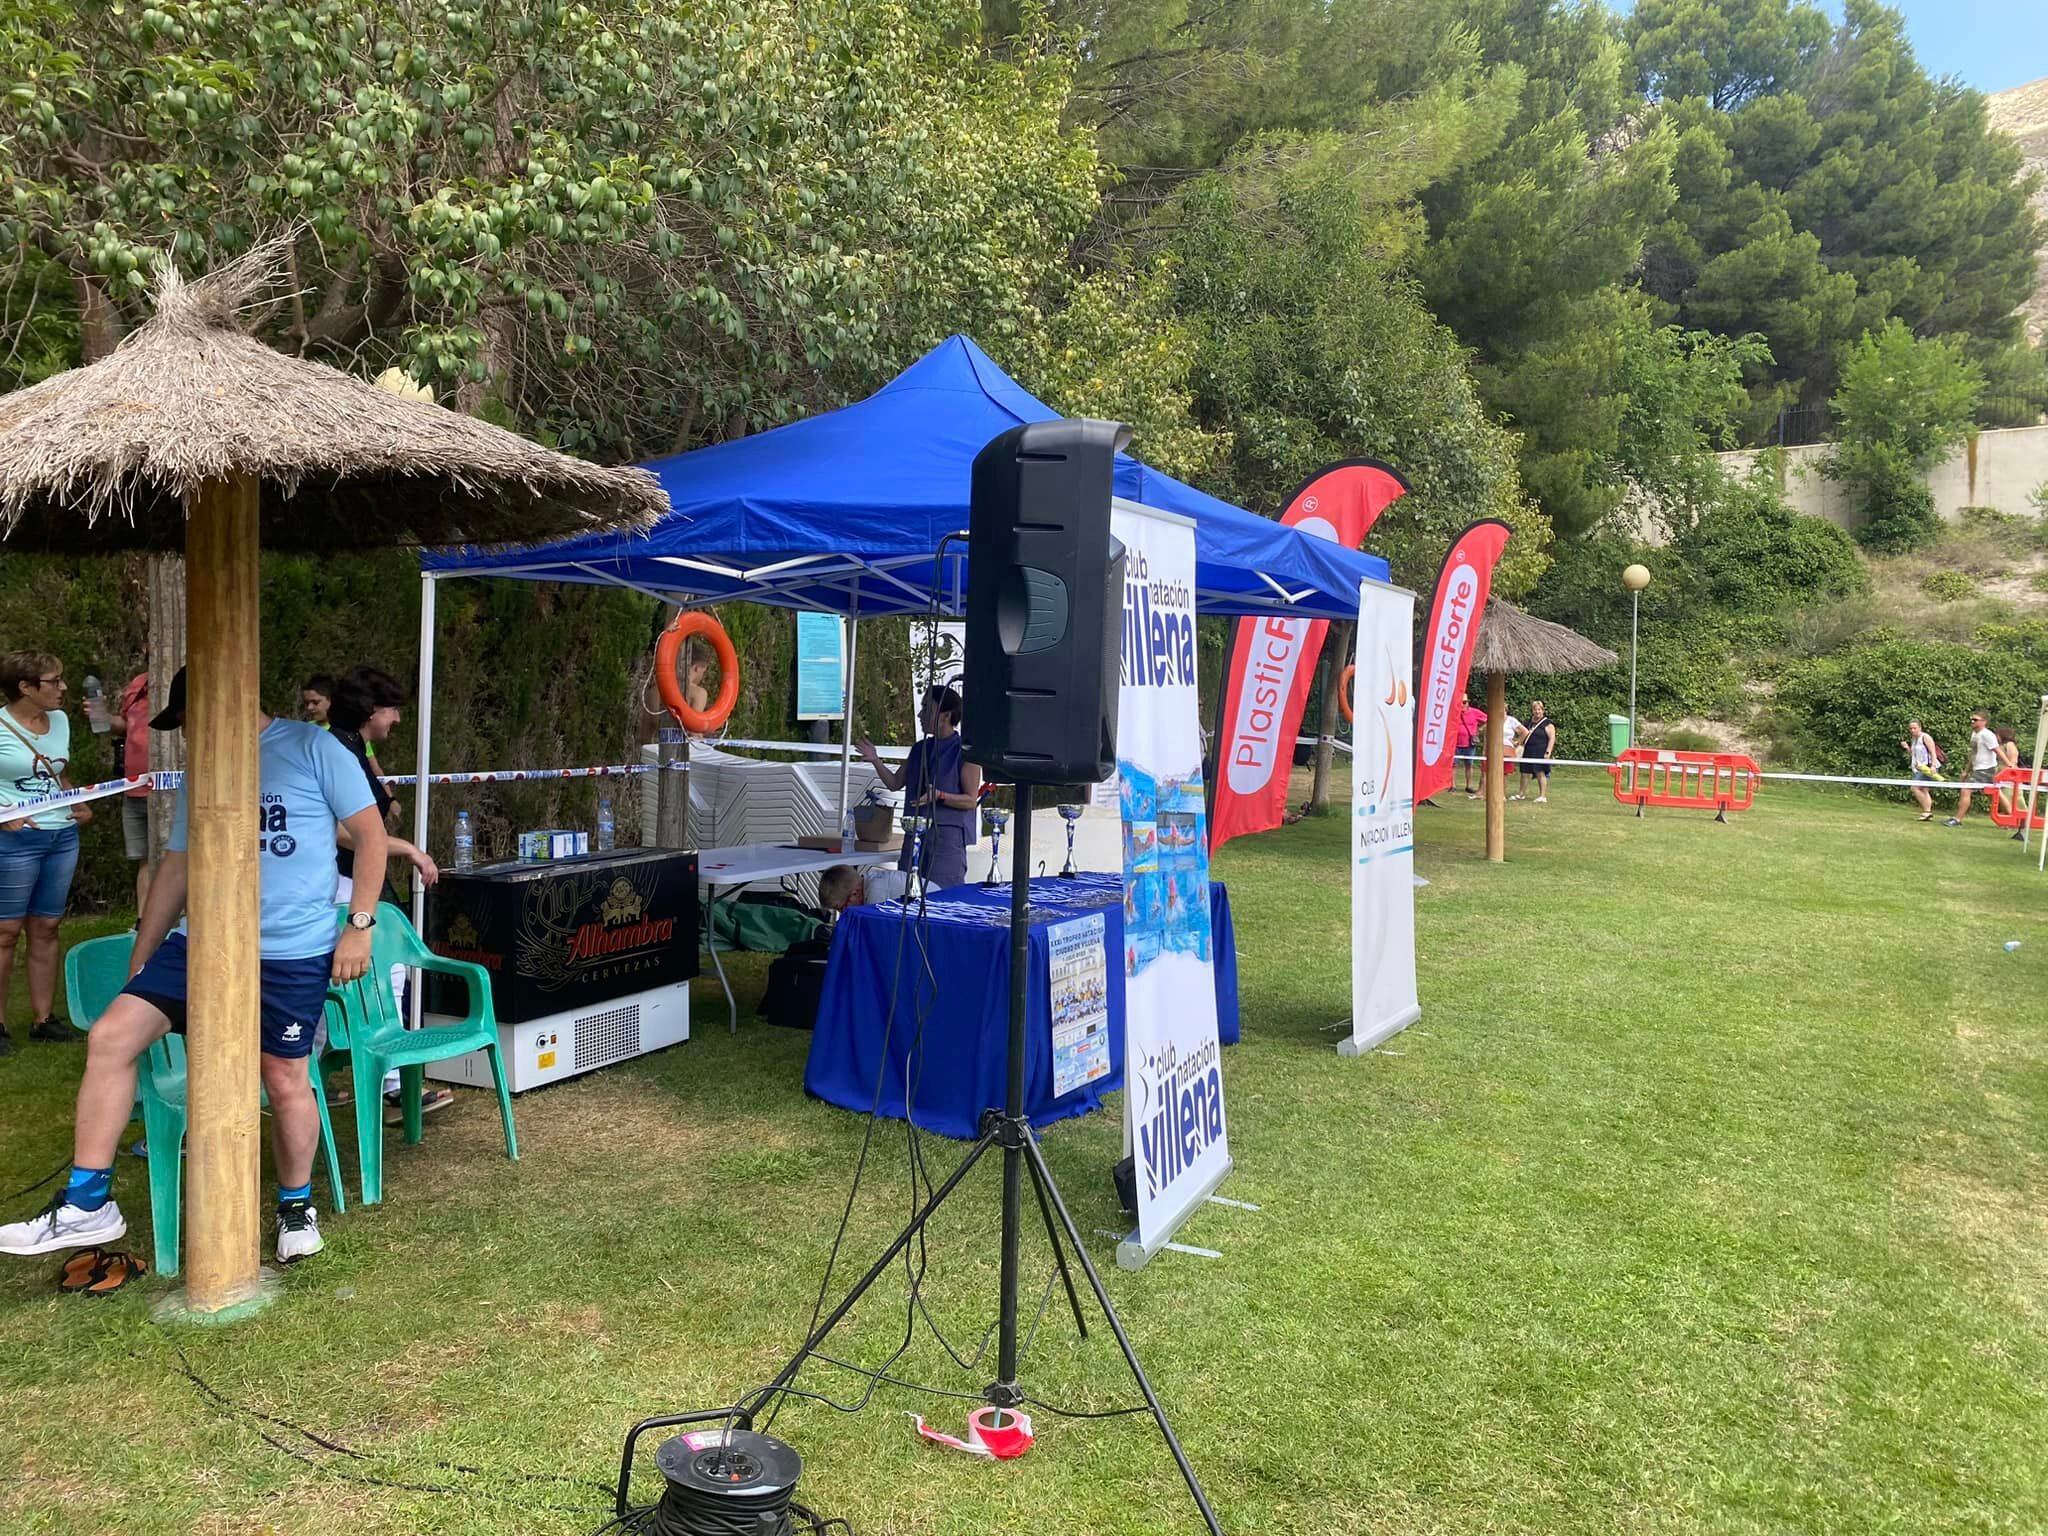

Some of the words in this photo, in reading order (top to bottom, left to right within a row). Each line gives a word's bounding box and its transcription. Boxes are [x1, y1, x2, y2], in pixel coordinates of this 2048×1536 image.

[1125, 550, 1147, 580] club
[1149, 579, 1190, 609] natación
[1426, 580, 1472, 746] PlasticForte
[1236, 616, 1297, 768] PlasticF
[566, 914, 673, 967] Alhambra
[581, 956, 661, 983] CERVEZAS
[1156, 1040, 1177, 1080] club
[1177, 1036, 1216, 1089] natación
[1140, 1067, 1222, 1201] villena
